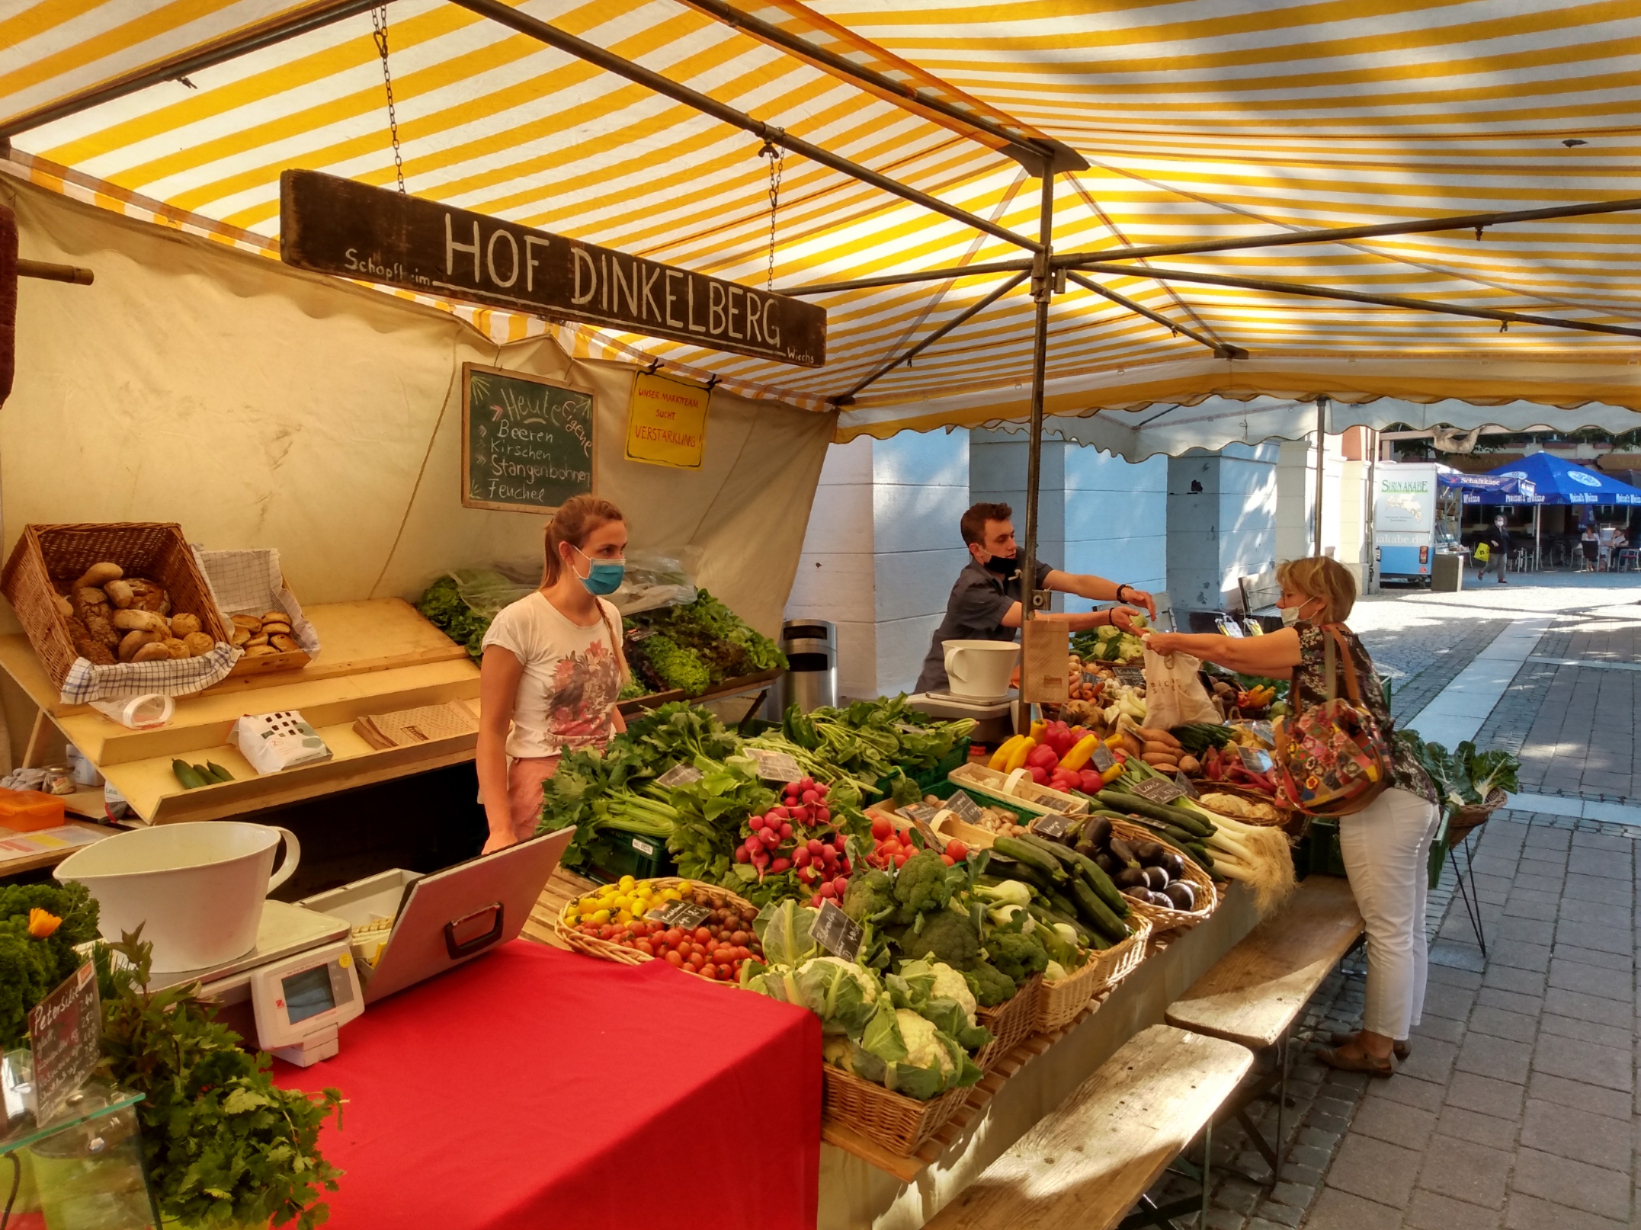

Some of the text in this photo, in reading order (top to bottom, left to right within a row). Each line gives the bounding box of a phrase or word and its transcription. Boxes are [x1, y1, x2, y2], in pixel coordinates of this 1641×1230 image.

[344, 248, 430, 286] Schopfhim
[445, 213, 780, 348] HOF DINKELBERG
[501, 388, 560, 427] Heute
[638, 387, 659, 399] UNSER
[497, 419, 554, 443] Beeren
[562, 400, 592, 458] Eigene
[655, 409, 676, 420] SUCHT
[490, 437, 551, 461] Kirschen
[491, 454, 591, 487] Stangenbohnen
